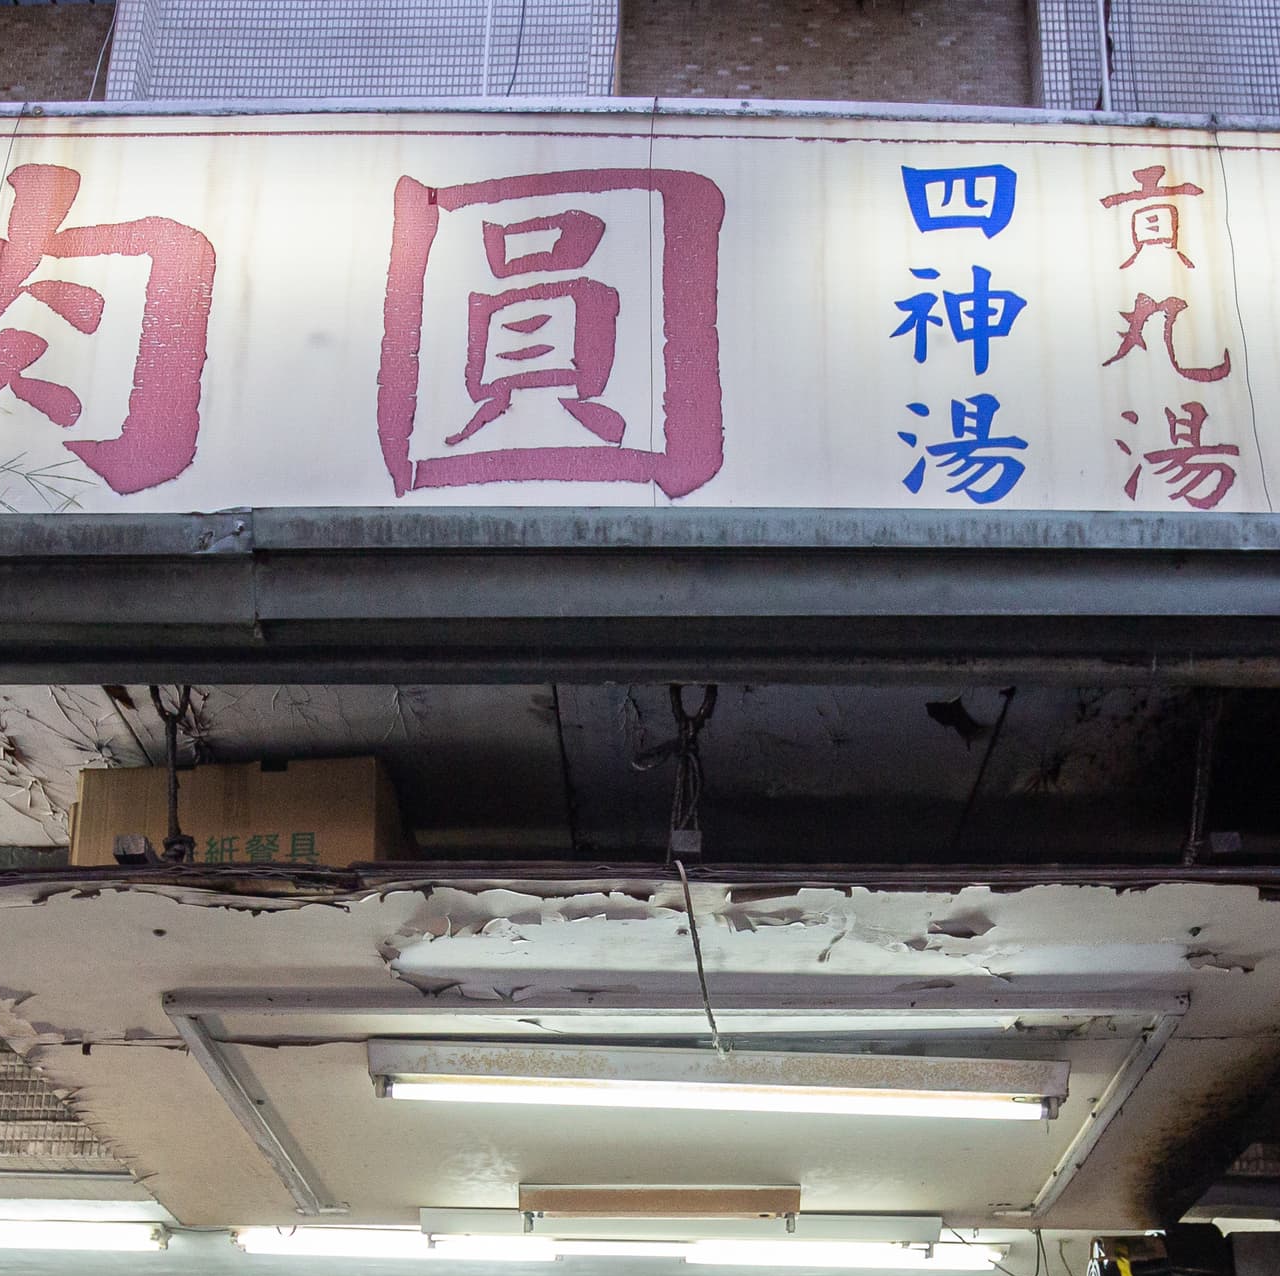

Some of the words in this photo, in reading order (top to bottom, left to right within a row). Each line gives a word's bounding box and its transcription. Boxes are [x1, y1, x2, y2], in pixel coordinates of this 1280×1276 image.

[893, 163, 1030, 505] 四神湯
[1099, 164, 1242, 510] 貢丸湯
